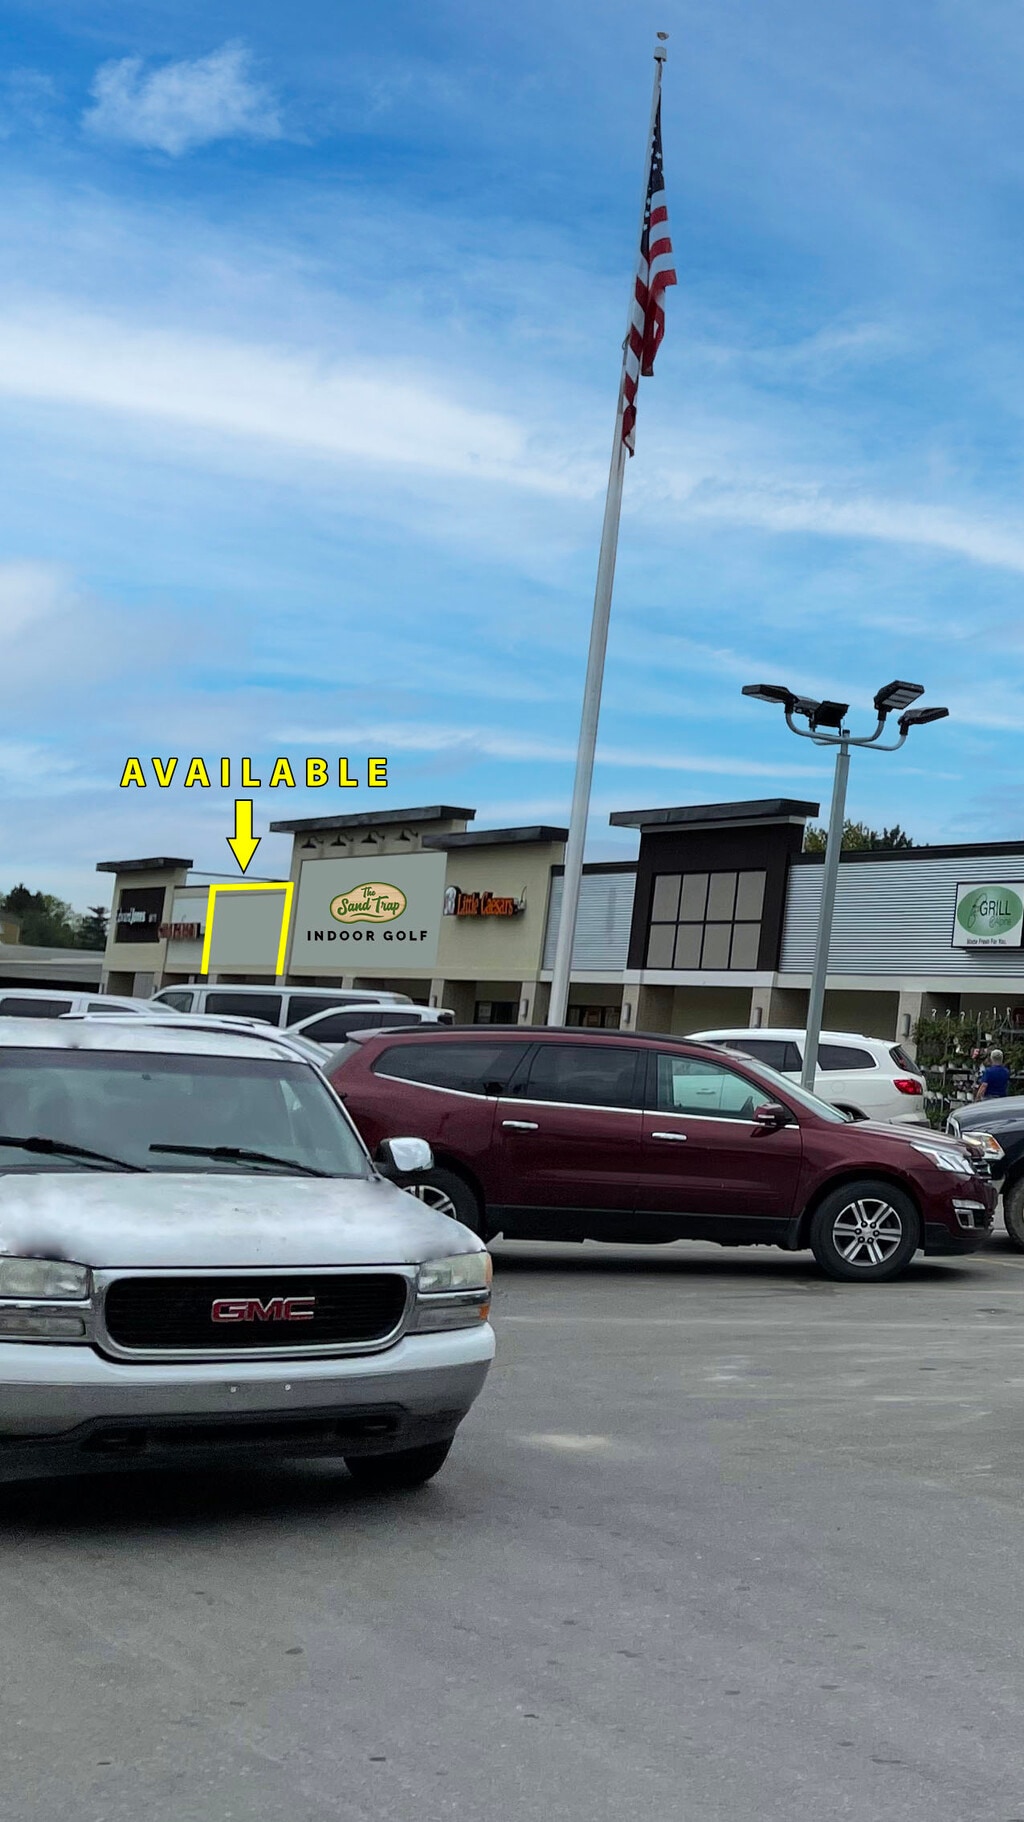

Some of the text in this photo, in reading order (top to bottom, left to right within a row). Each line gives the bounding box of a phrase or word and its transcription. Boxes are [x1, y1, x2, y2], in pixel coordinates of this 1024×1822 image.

[361, 886, 376, 898] The
[337, 895, 400, 915] Sand Trap
[980, 899, 1011, 916] GRILL
[307, 930, 427, 941] INDOOR GOLF
[211, 1296, 315, 1322] GMC
